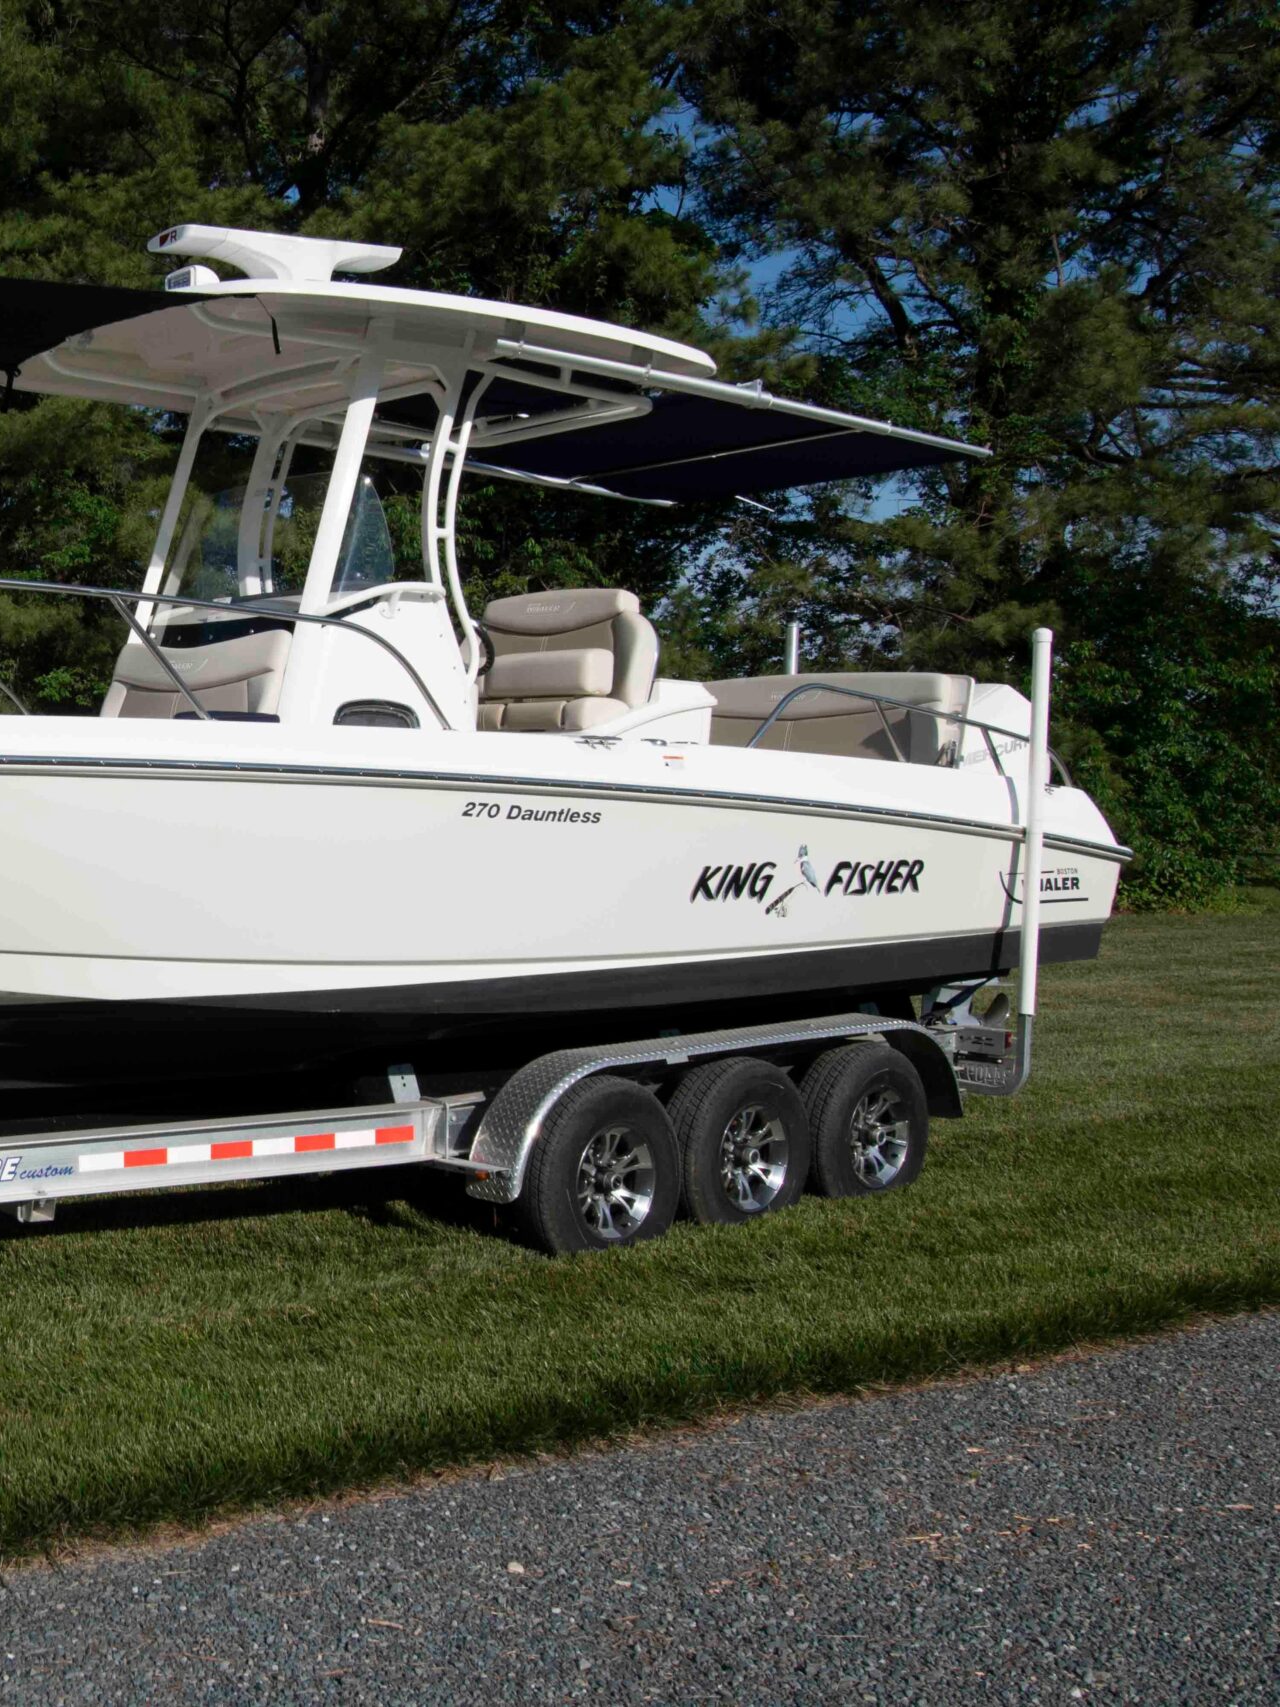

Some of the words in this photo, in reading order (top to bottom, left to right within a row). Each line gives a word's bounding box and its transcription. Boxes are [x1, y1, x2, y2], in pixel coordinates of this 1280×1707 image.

[461, 802, 500, 818] 270
[506, 805, 602, 823] Dauntless
[689, 862, 777, 904] KING
[824, 859, 924, 897] FISHER
[19, 1164, 74, 1180] custom
